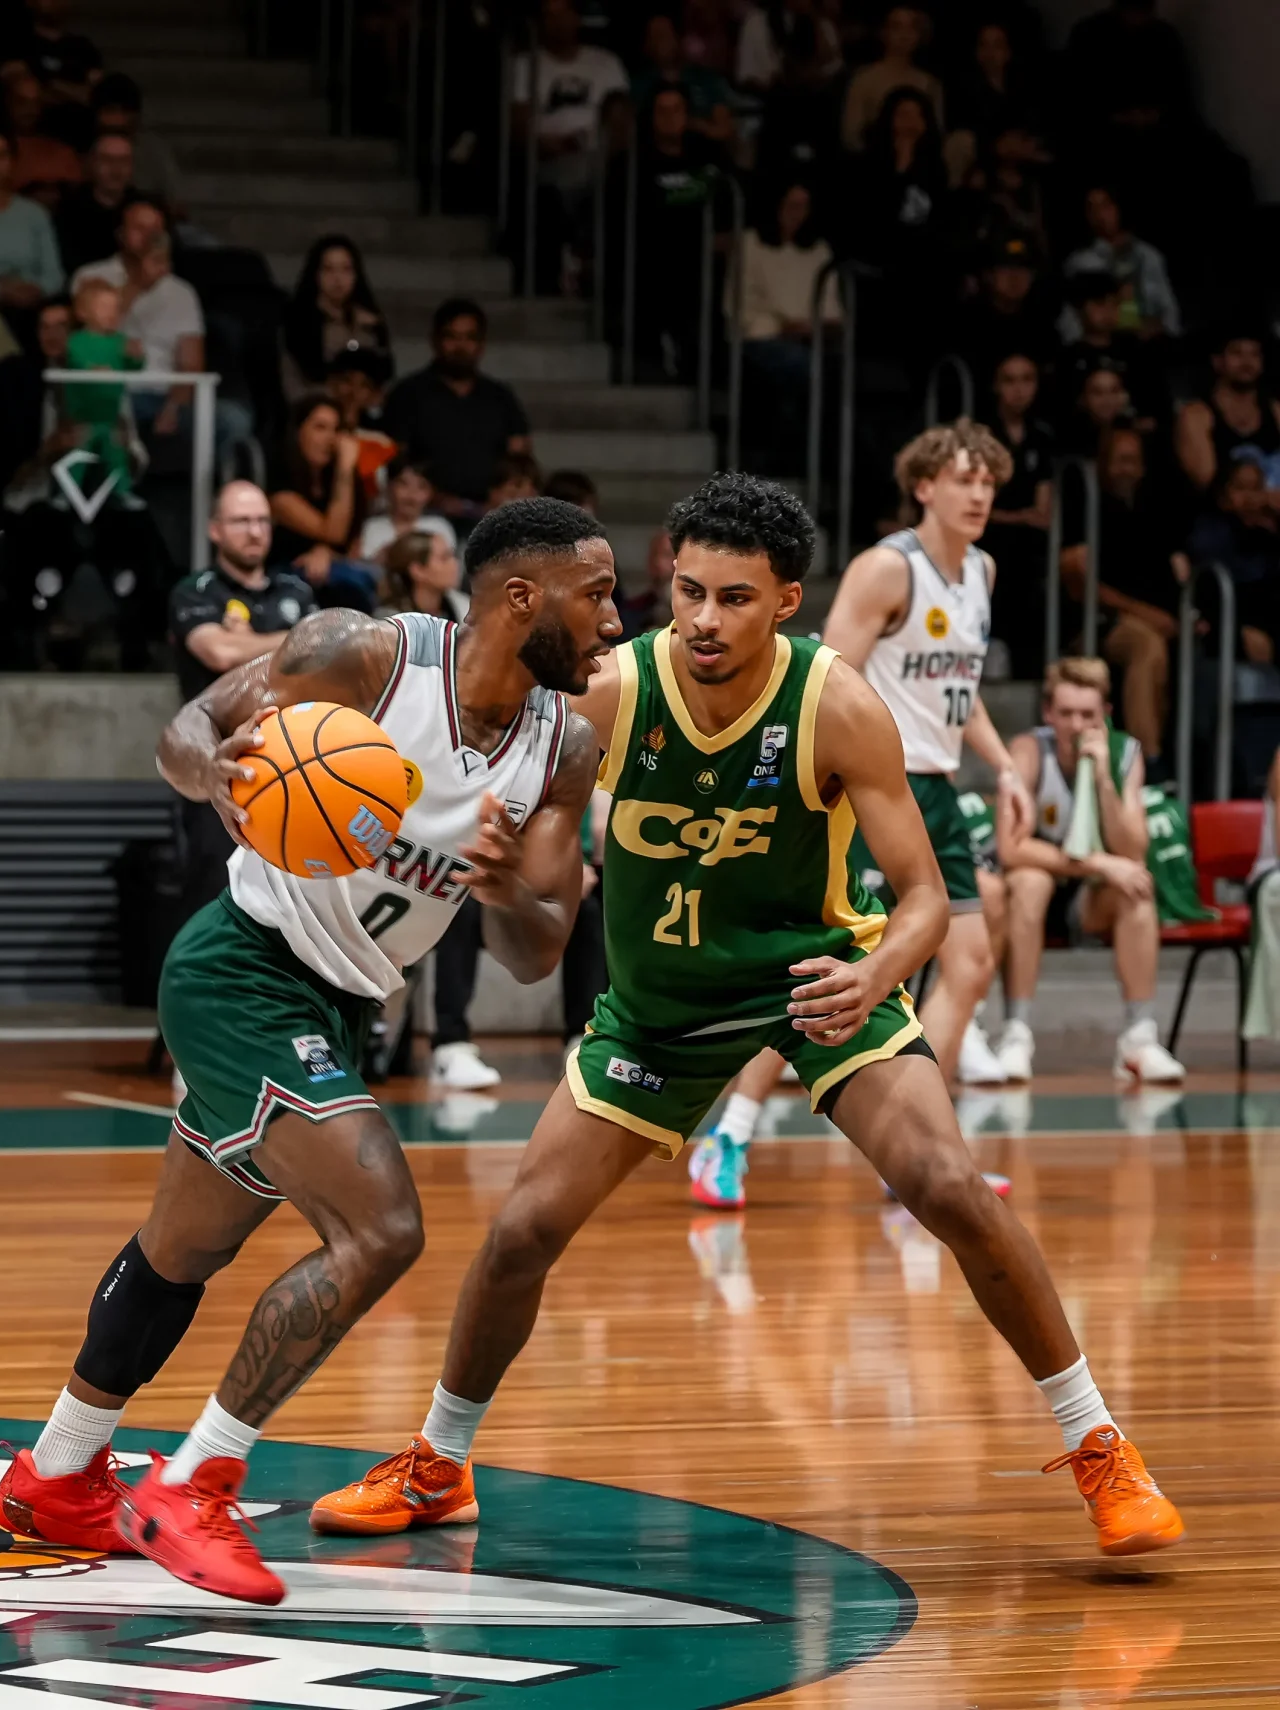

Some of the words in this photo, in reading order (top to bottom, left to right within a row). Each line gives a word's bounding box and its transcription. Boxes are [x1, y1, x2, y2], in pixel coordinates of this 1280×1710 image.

[943, 686, 970, 726] 10
[637, 750, 658, 770] AIS
[753, 765, 776, 776] ONE
[653, 882, 702, 947] 21
[644, 1072, 664, 1086] ONE
